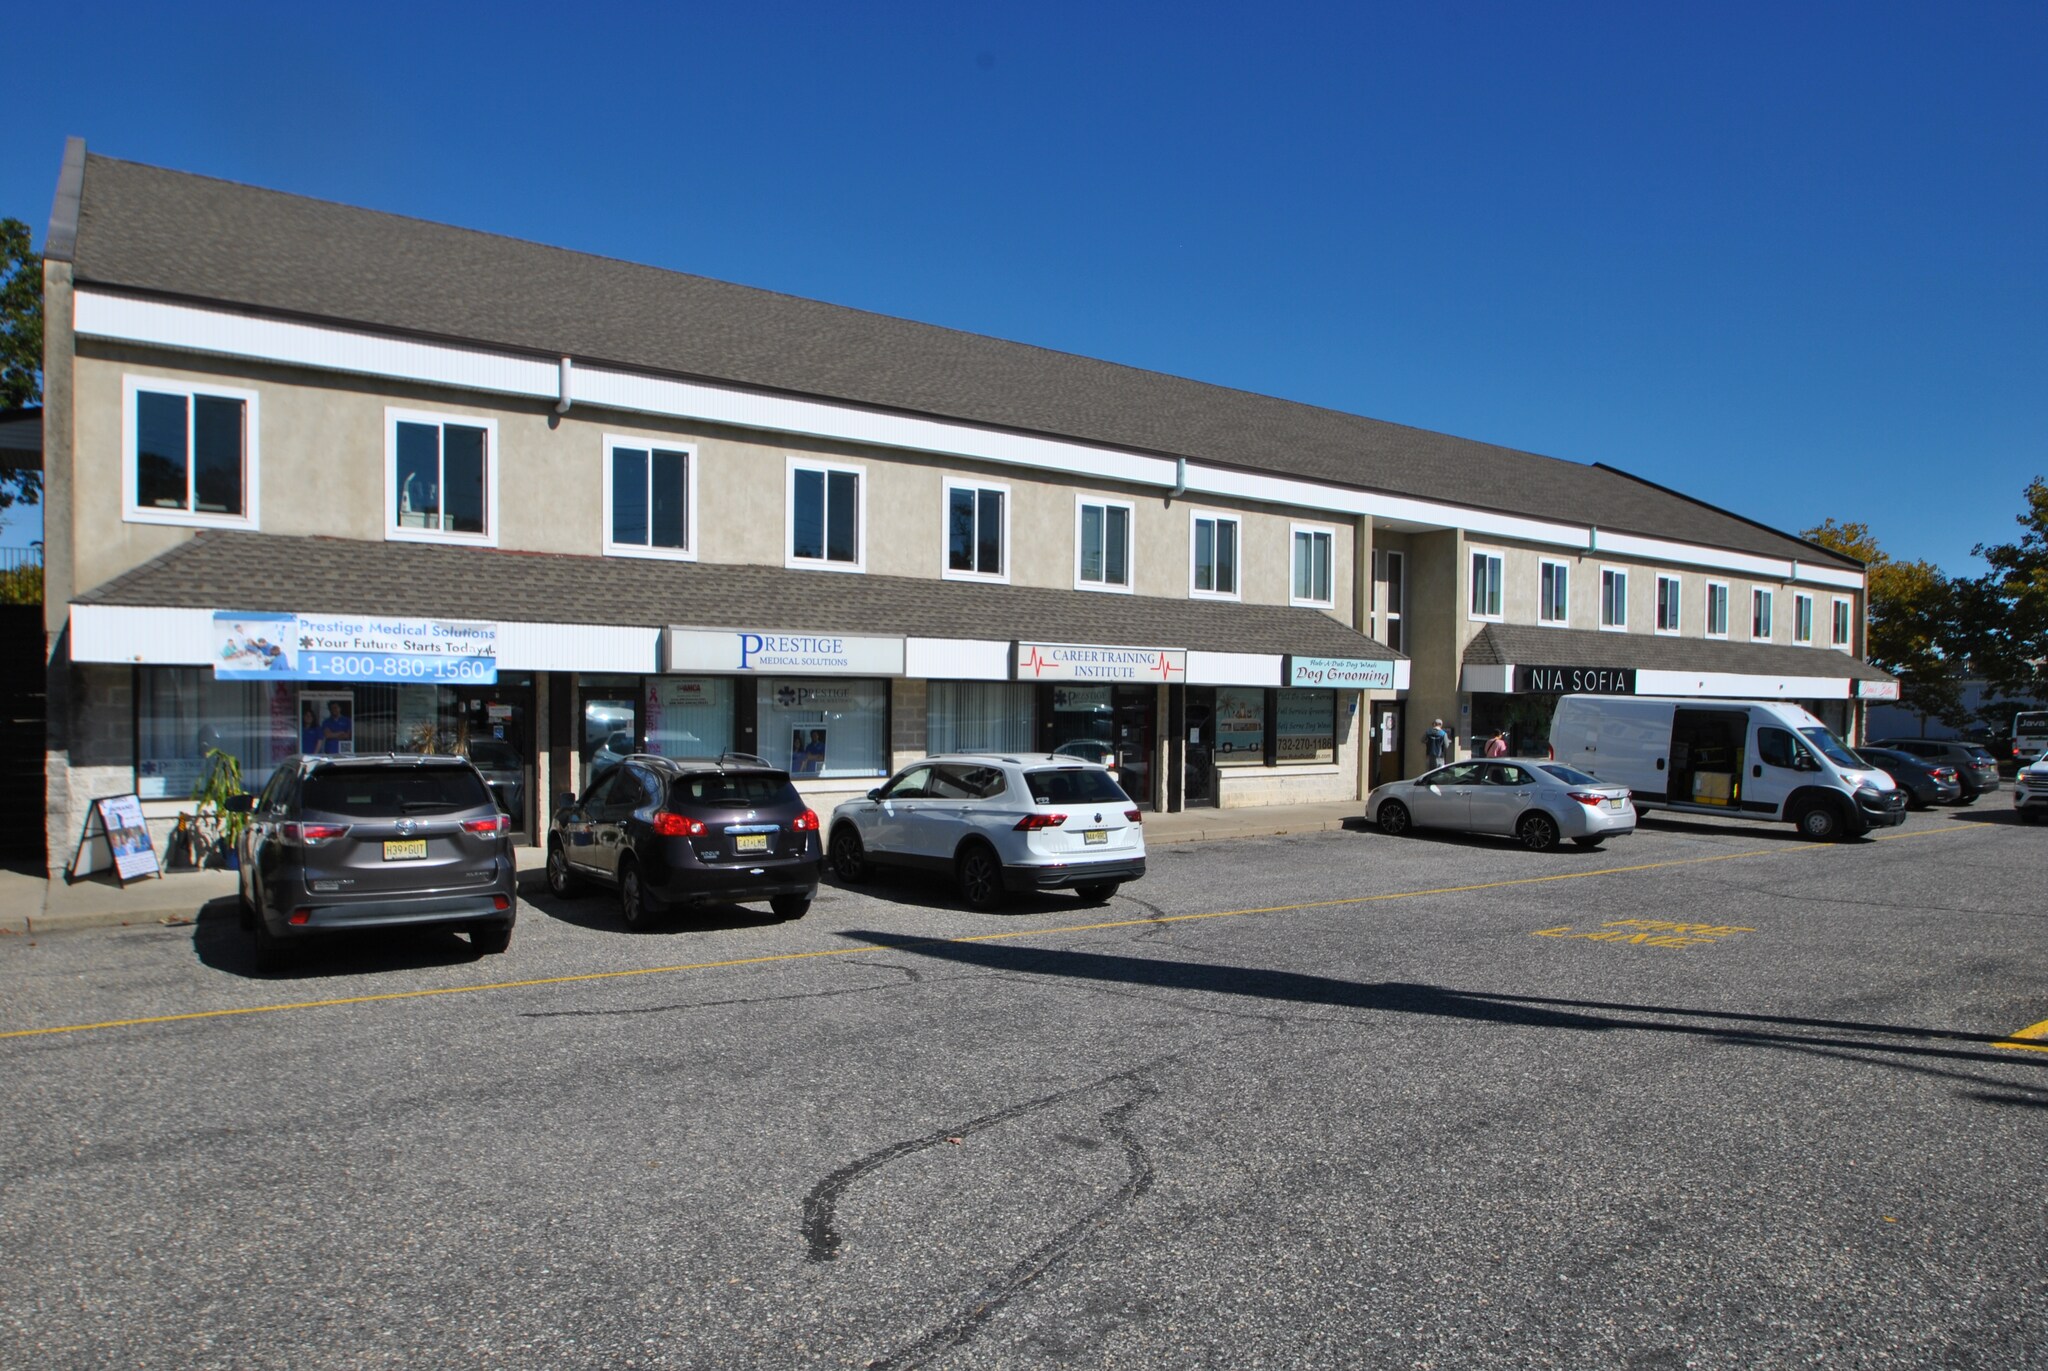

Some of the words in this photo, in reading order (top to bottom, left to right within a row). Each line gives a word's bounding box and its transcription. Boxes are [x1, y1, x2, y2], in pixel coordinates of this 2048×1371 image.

[299, 619, 364, 636] Prestige
[369, 622, 427, 636] Medical
[432, 625, 496, 640] Solutions
[316, 637, 349, 649] Your
[354, 638, 398, 650] Future
[403, 640, 441, 652] Starts
[446, 642, 483, 656] Today
[736, 633, 843, 670] PRESTIGE
[1052, 649, 1099, 663] CAREER
[1099, 651, 1155, 664] TRAINING
[307, 655, 485, 679] 1-800-880-1560
[759, 656, 800, 666] MEDICAL
[801, 657, 849, 667] SOLUTIONS
[1074, 665, 1136, 678] INSTITUTE
[1296, 666, 1323, 684] Dog
[1326, 668, 1390, 686] Grooming
[1532, 669, 1564, 690] NIA
[1572, 670, 1626, 691] SOFIA
[2020, 719, 2046, 727] Java
[1529, 926, 1717, 949] LANE
